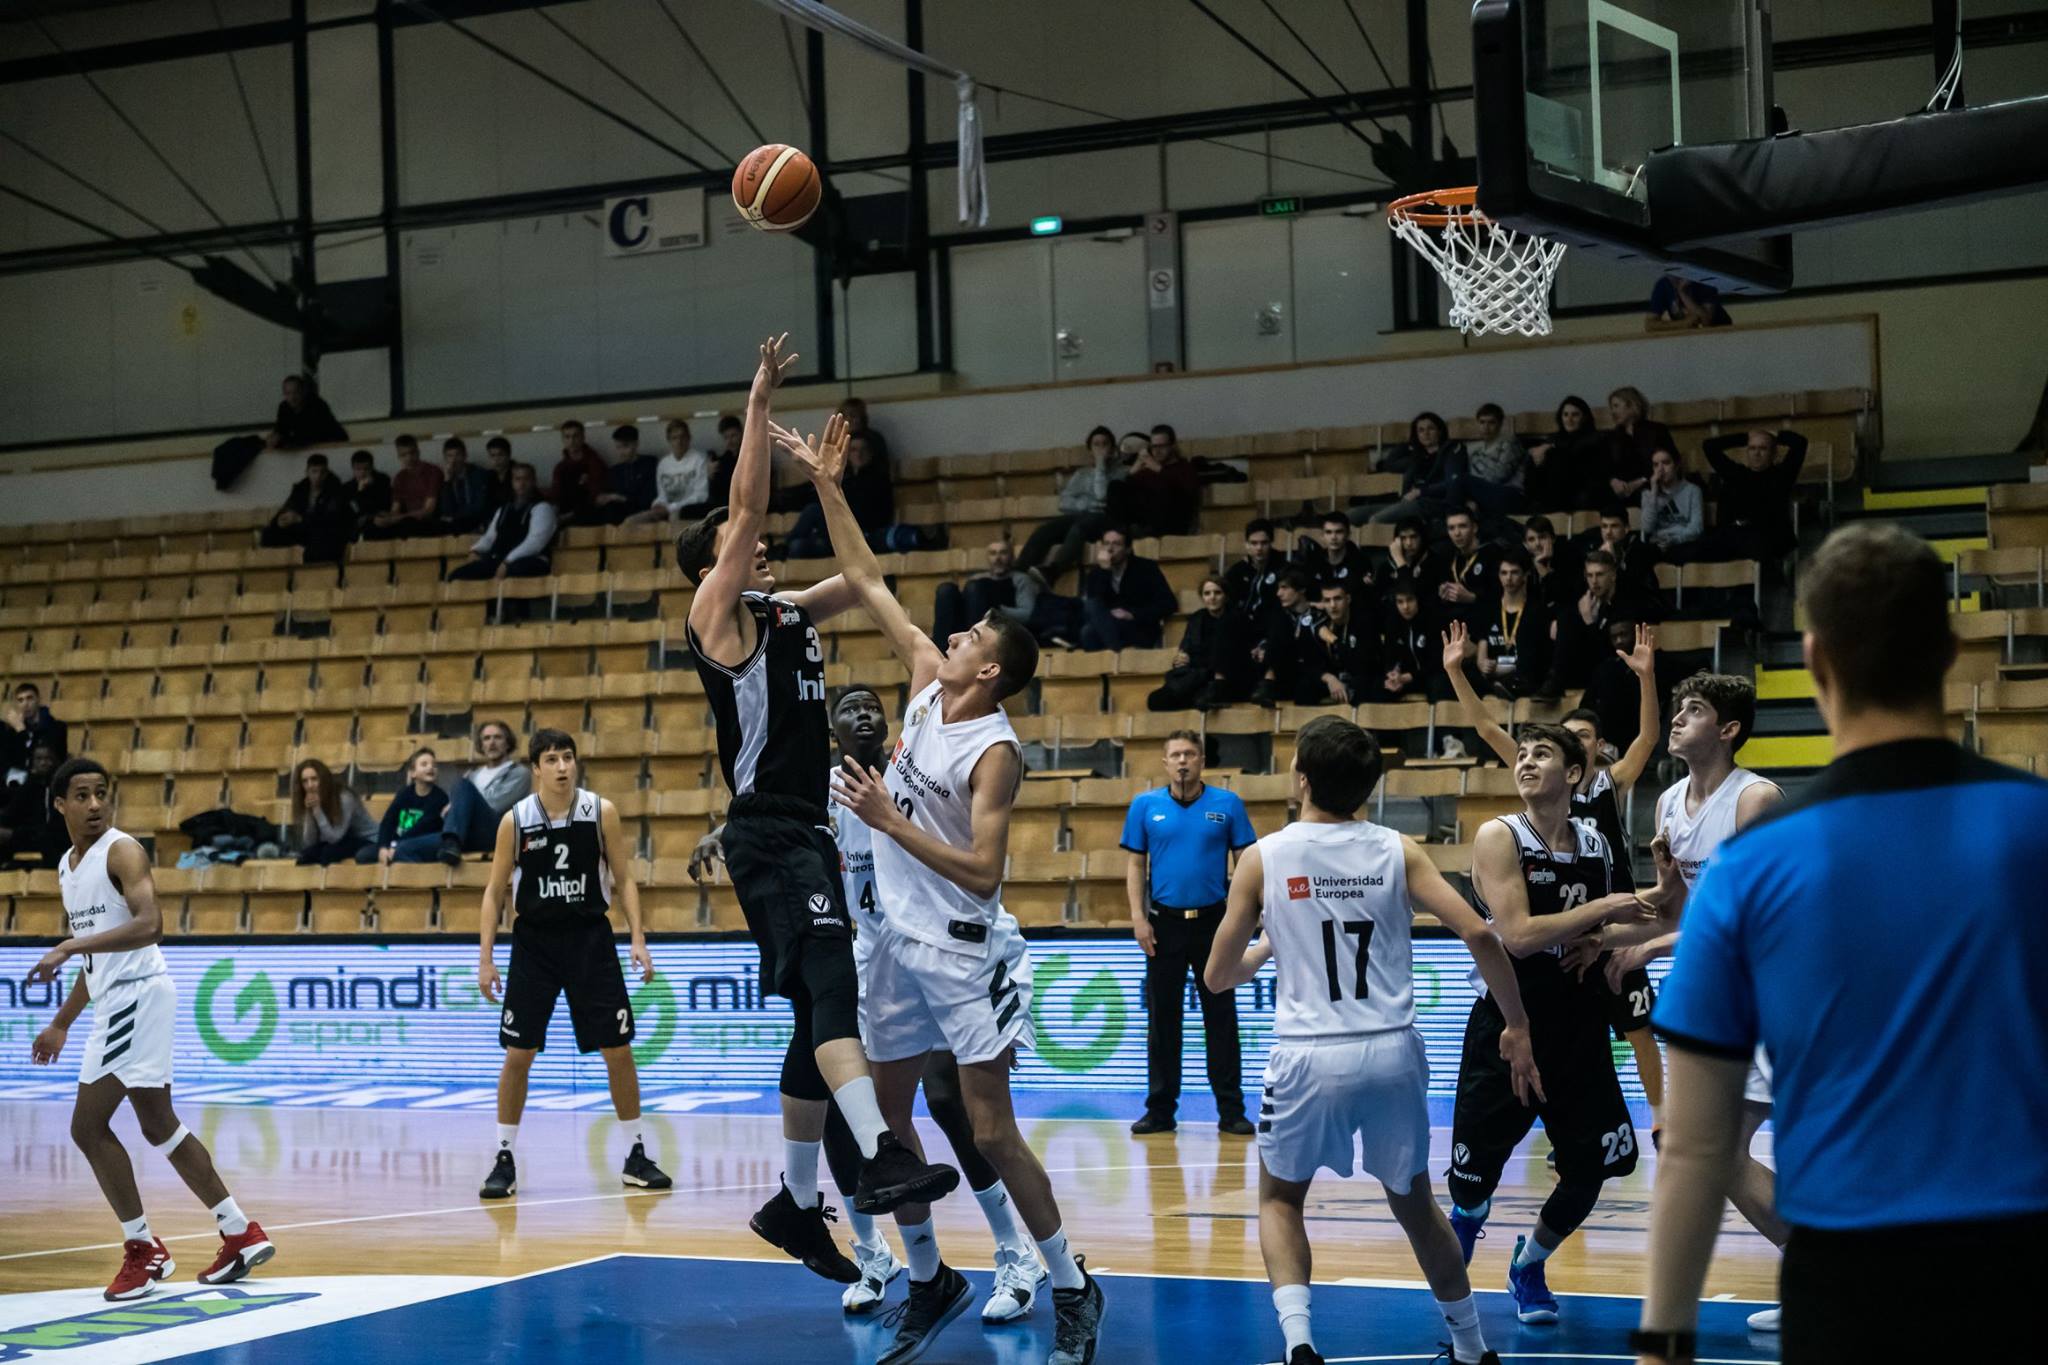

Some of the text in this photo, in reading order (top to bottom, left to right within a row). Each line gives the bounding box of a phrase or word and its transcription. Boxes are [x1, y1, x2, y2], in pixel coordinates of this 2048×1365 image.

[609, 197, 649, 248] C
[553, 843, 570, 870] 2
[538, 873, 588, 903] Unipol
[860, 880, 876, 914] 4
[1313, 875, 1384, 887] Universidad
[1315, 887, 1365, 900] Europea
[1321, 919, 1375, 1003] 17
[287, 1015, 413, 1053] sport
[616, 1008, 629, 1035] 2
[1601, 1121, 1634, 1167] 23
